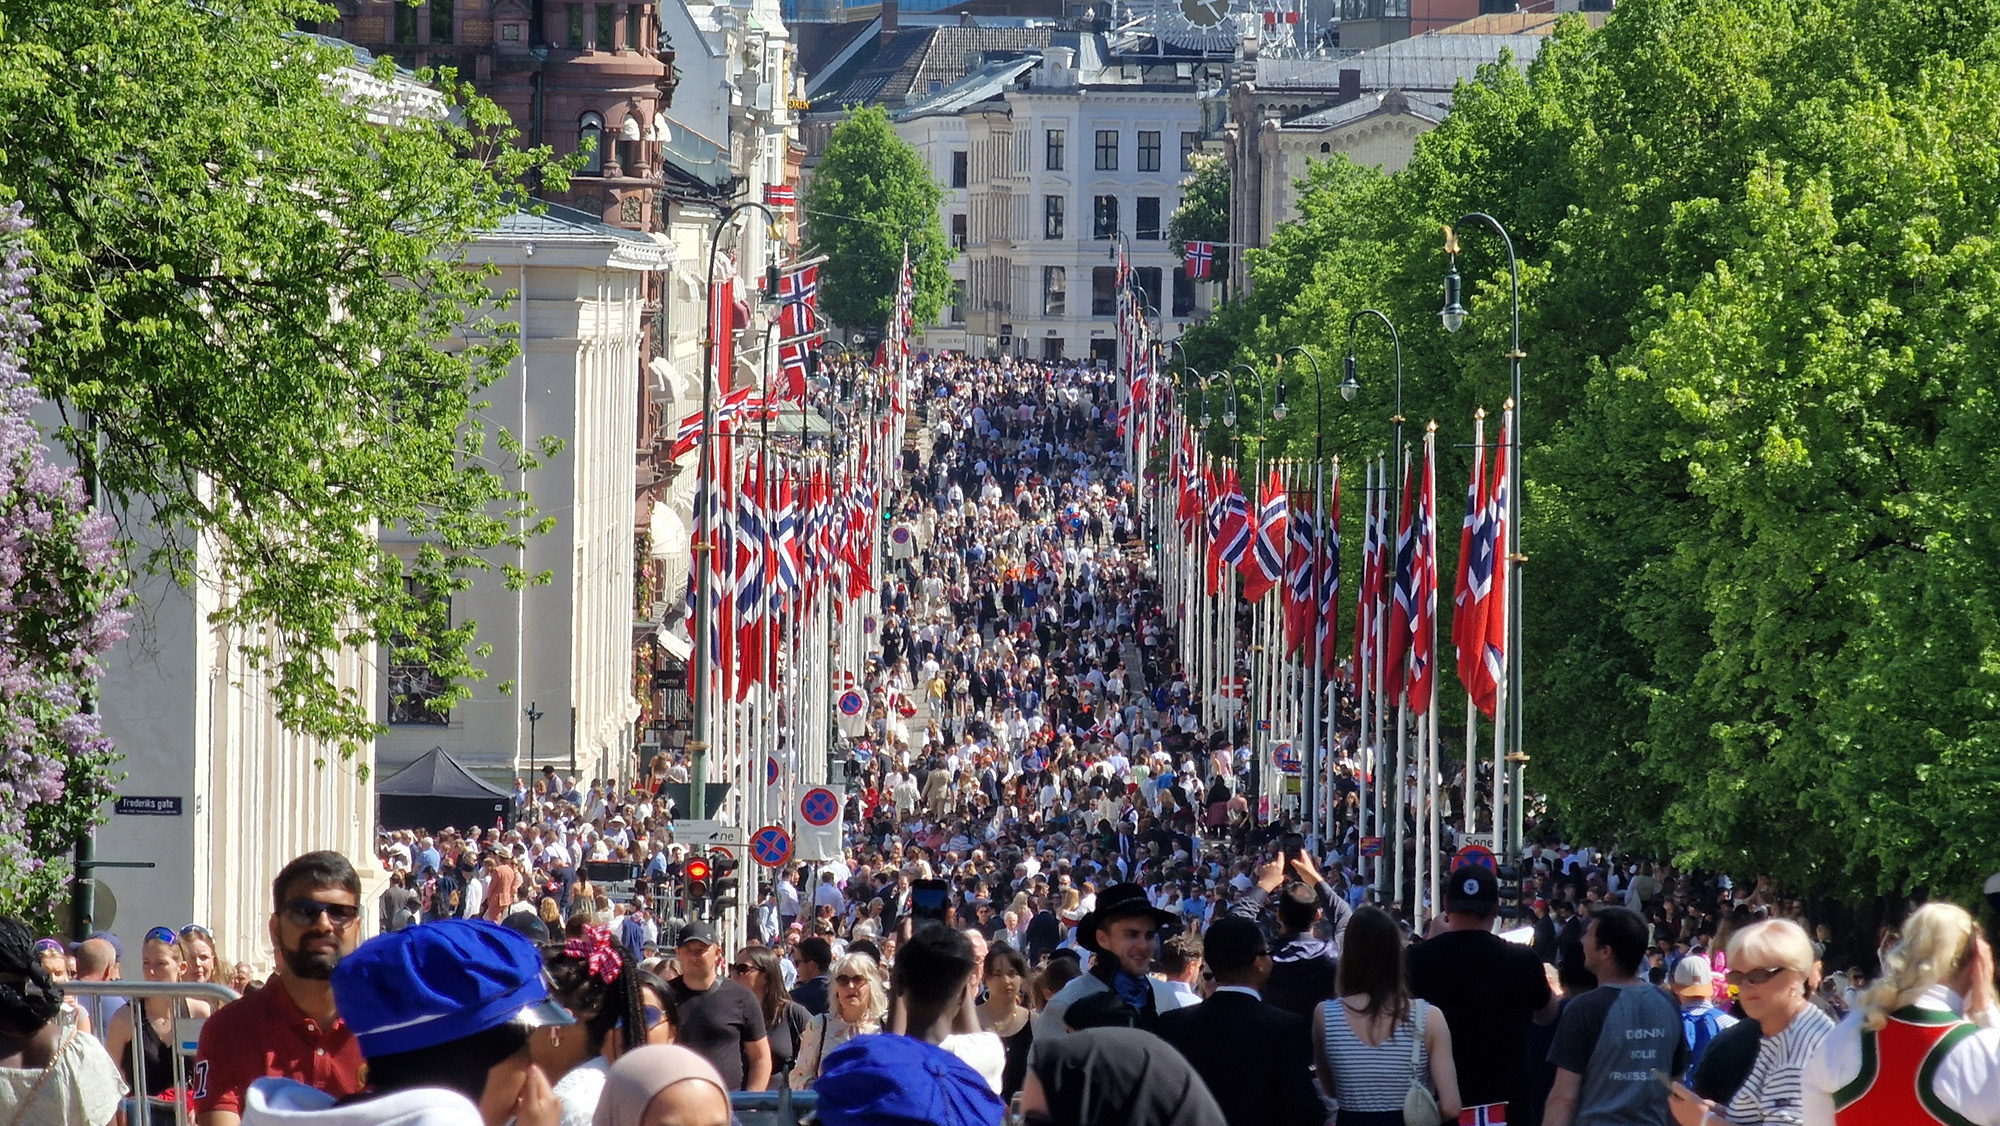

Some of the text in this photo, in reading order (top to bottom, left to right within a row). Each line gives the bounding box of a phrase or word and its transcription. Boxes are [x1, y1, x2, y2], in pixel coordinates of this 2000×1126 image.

[123, 799, 174, 810] Frederiks gate
[720, 832, 734, 841] ne
